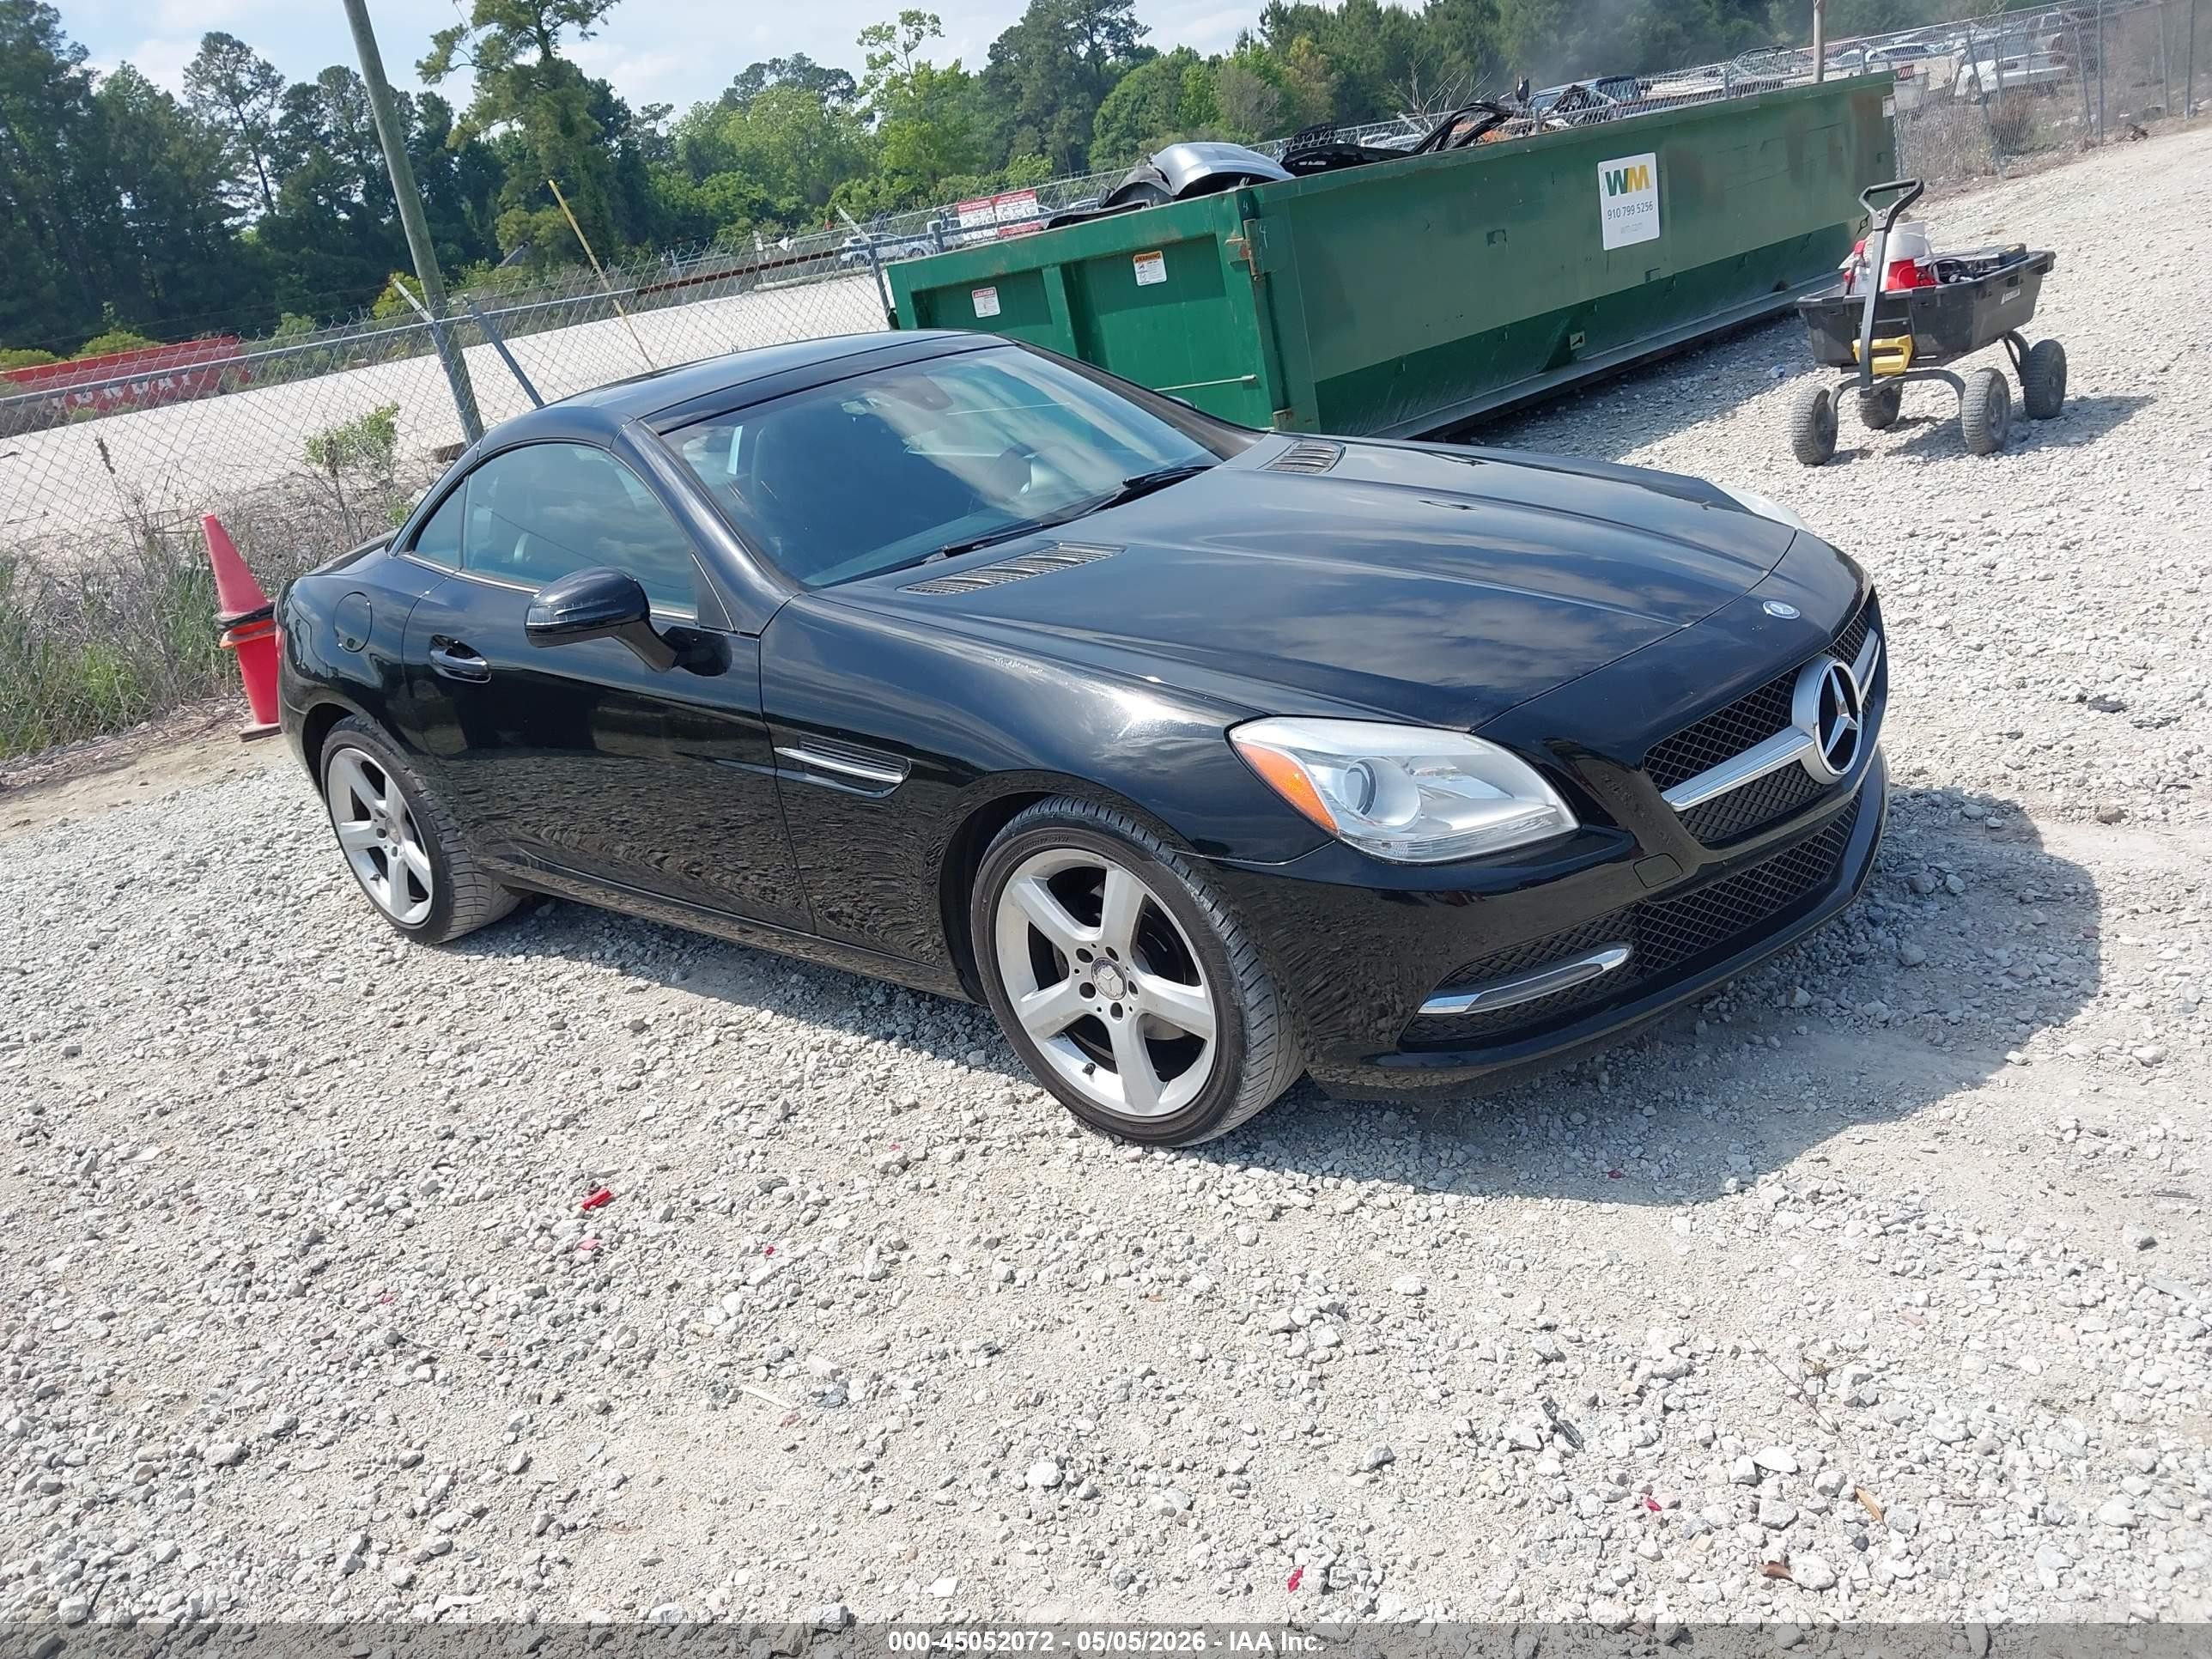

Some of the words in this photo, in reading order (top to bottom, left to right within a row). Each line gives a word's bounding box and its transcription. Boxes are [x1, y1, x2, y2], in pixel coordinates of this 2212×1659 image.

[1605, 165, 1650, 197] WM
[1607, 207, 1621, 220] 910
[1622, 205, 1636, 217] 799
[1637, 201, 1654, 214] 5256
